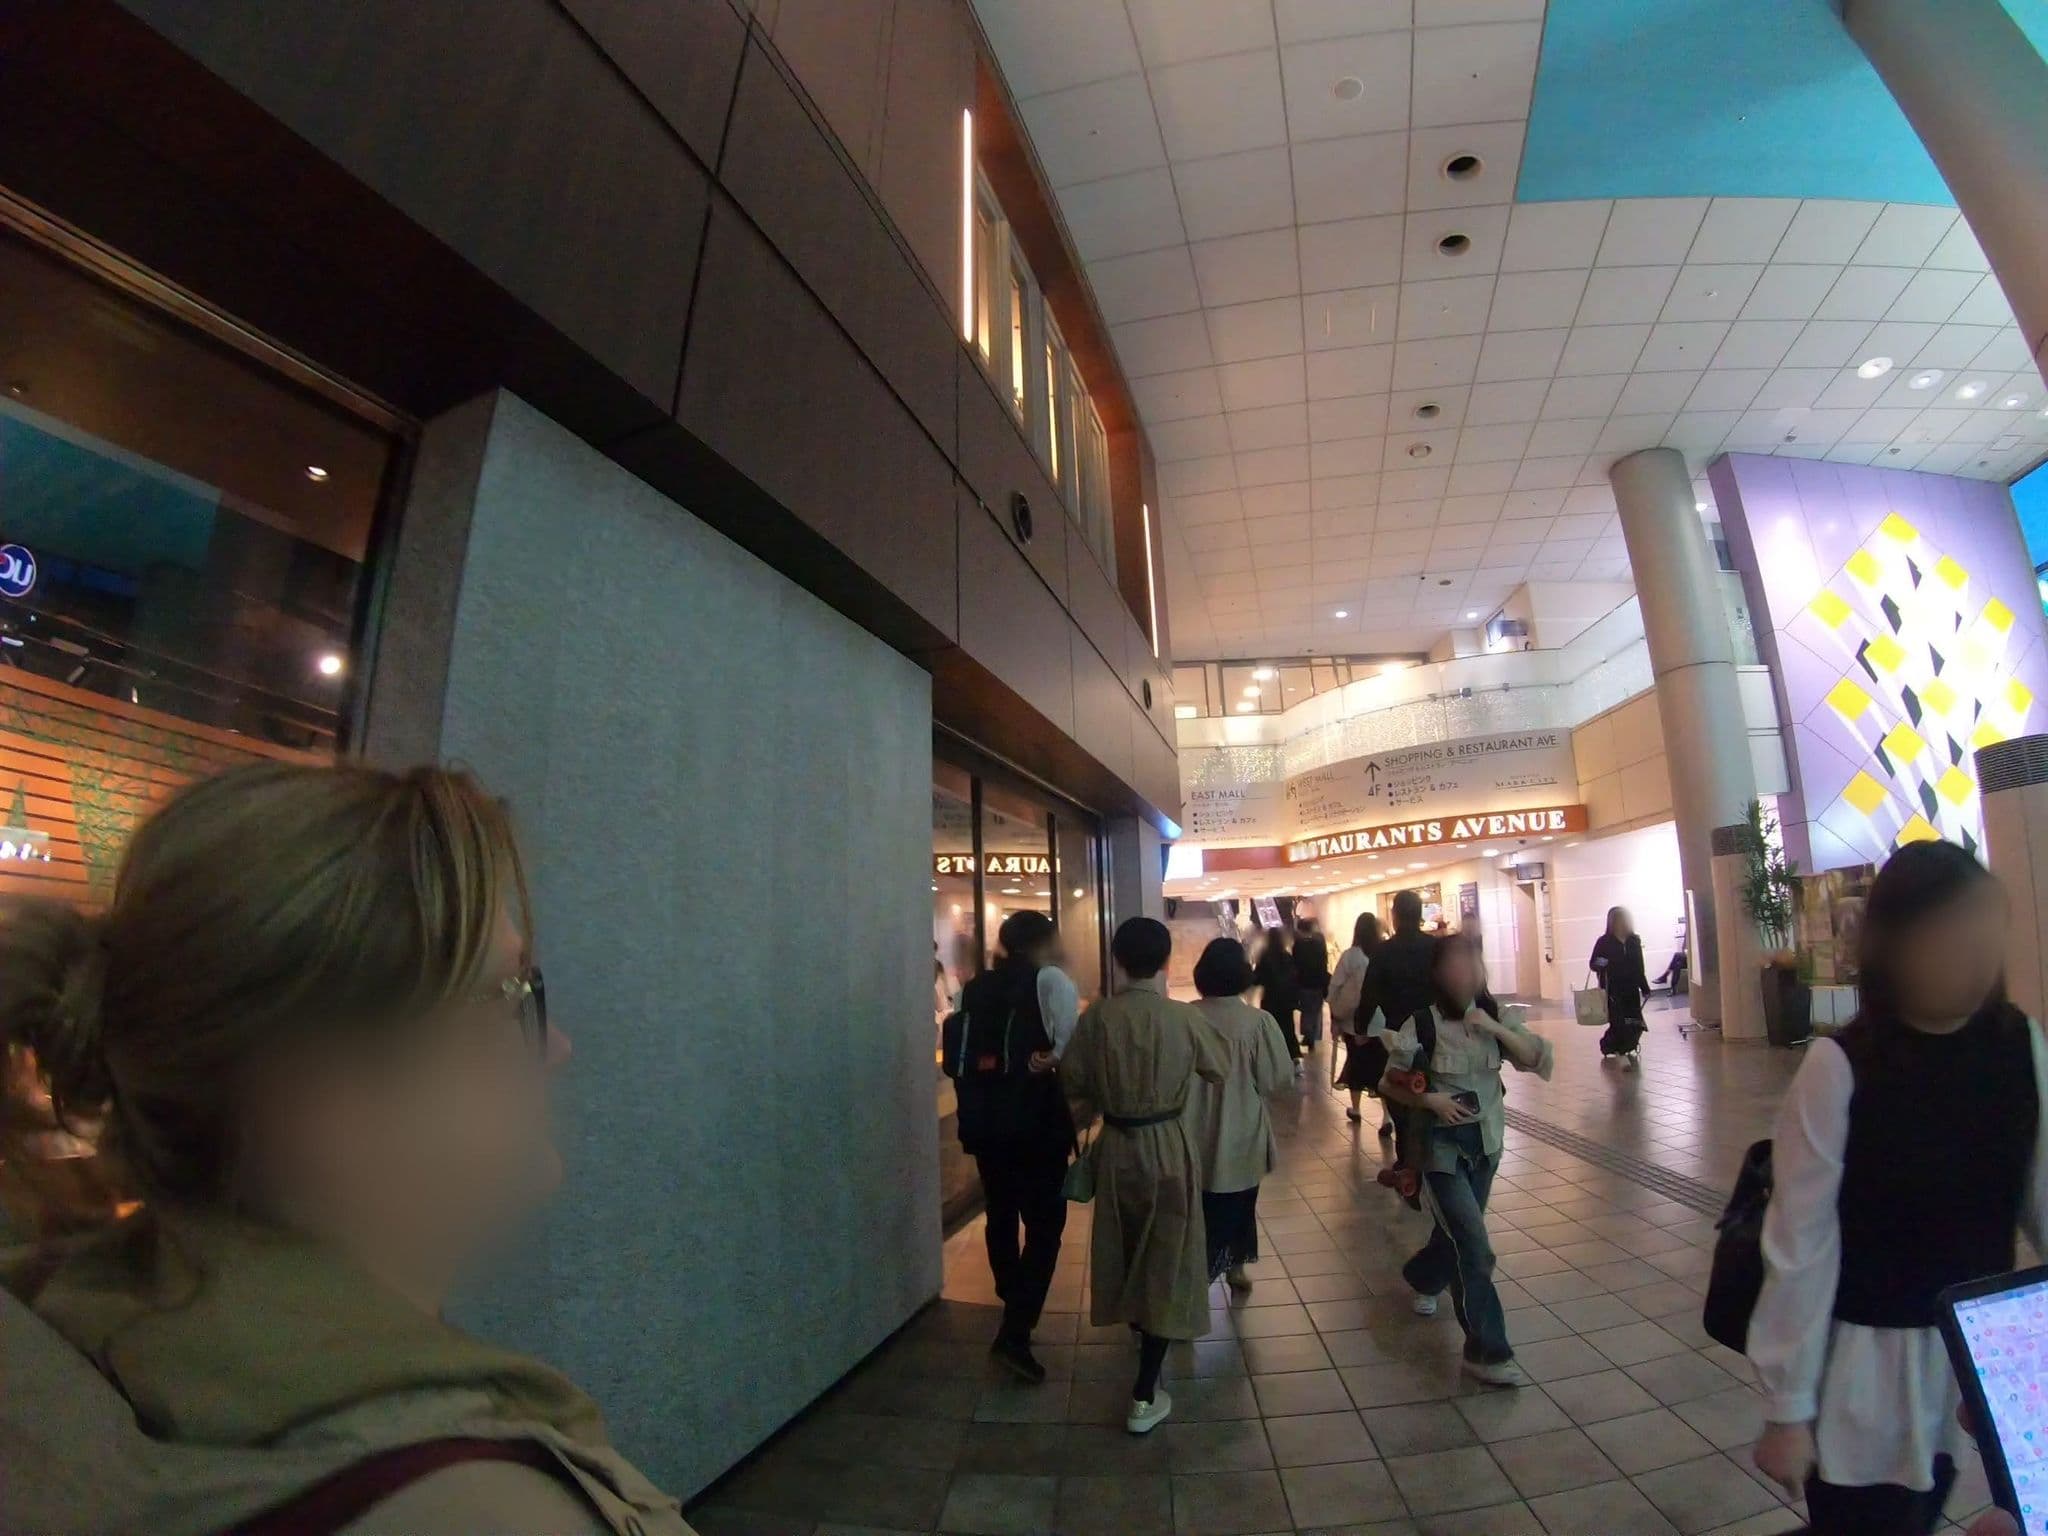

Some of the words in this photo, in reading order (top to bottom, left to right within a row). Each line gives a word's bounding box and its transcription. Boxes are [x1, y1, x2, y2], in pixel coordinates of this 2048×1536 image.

[1384, 749, 1443, 767] SHOPPING
[1446, 746, 1455, 757] &
[1458, 737, 1534, 755] RESTAURANT
[1536, 735, 1557, 747] AVE
[1191, 790, 1216, 801] EAST
[1218, 788, 1247, 799] MALL
[1451, 810, 1566, 838] AVENUE
